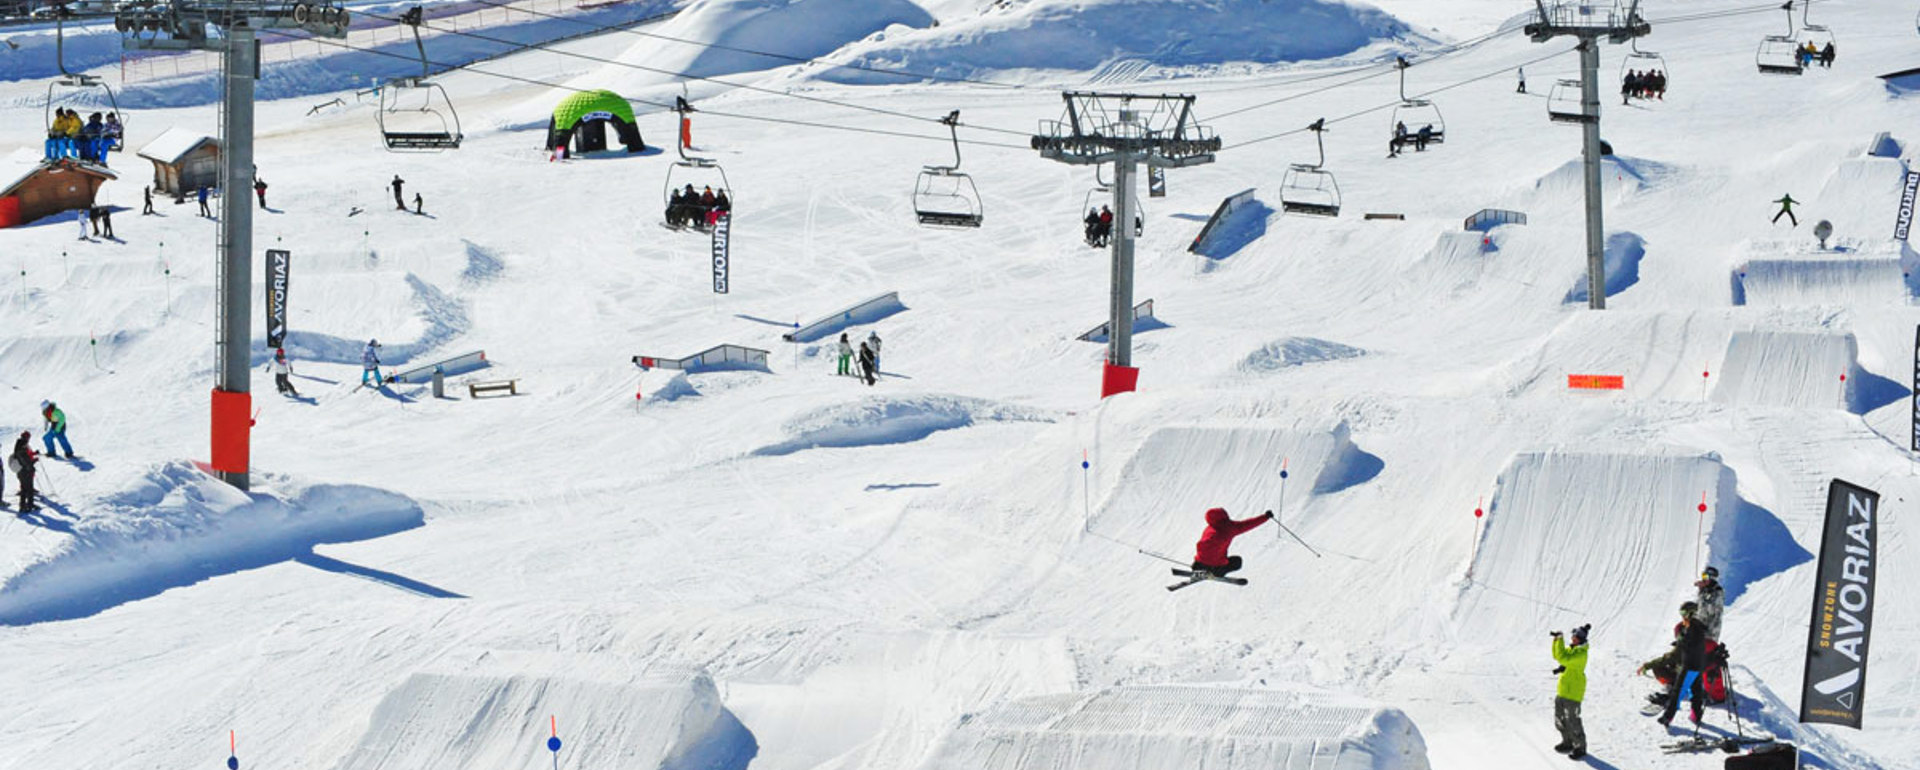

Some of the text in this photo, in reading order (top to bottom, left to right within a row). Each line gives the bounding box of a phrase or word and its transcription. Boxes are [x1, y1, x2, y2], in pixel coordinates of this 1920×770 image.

[274, 253, 286, 322] AVORIAZ
[1833, 492, 1872, 663] AVORIAZ
[1819, 581, 1837, 648] SNOWZONE
